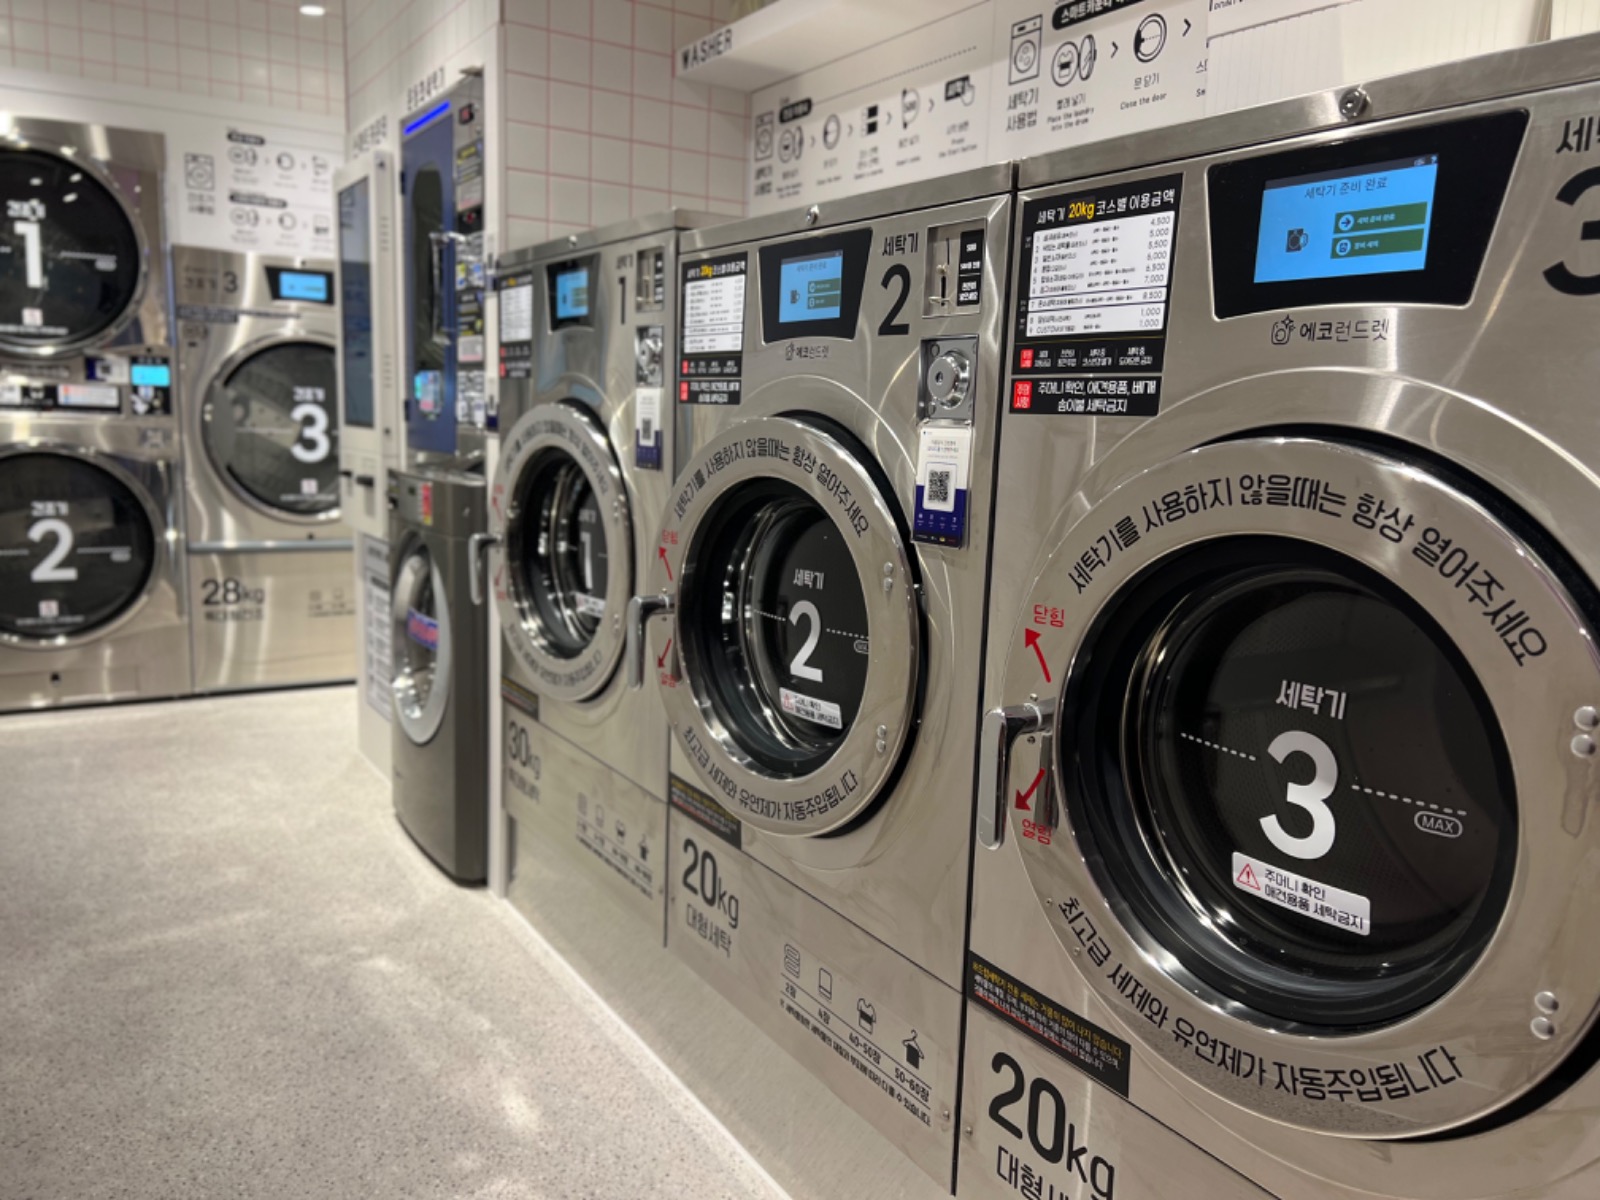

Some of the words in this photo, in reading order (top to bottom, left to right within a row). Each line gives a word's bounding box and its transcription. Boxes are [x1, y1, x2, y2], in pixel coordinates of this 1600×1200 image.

[682, 29, 732, 69] WASHER
[1151, 92, 1167, 102] door
[1037, 207, 1066, 224] 세탁기
[1068, 202, 1096, 220] 20kg
[1096, 197, 1128, 216] 코스별
[1129, 188, 1176, 210] 이용금액
[1305, 184, 1336, 199] 세탁기
[1339, 180, 1361, 196] 준비
[1365, 176, 1388, 191] 완료
[14, 220, 43, 288] 1
[882, 232, 919, 255] 세탁기
[223, 271, 238, 293] 3
[878, 264, 911, 336] 2
[1298, 320, 1389, 343] 에코런드렛
[1038, 382, 1064, 395] 주머니
[1086, 398, 1128, 413] 세탁금지
[290, 402, 330, 463] 3
[675, 469, 706, 522] 세탁기를
[705, 441, 744, 478] 사용하지
[746, 437, 790, 461] 않을때는
[792, 446, 816, 474] 항상
[816, 462, 869, 538] 열어주세요
[27, 518, 78, 582] 2
[793, 569, 824, 590] 세탁기
[1068, 515, 1142, 595] 세탁기를
[1142, 476, 1233, 533] 사용하지
[1239, 473, 1347, 519] 않을때는
[1352, 492, 1416, 544] 항상
[1411, 527, 1548, 668] 열어주세요
[1033, 604, 1065, 628] 닫힘
[789, 600, 823, 682] 2
[1275, 679, 1347, 720] 세탁기
[739, 788, 781, 820] 유연제가
[783, 768, 859, 821] 자동주입됩니다
[1259, 730, 1339, 860] 3
[1022, 819, 1053, 846] 열림
[1421, 815, 1455, 835] MAX
[683, 838, 738, 929] 20kg
[1264, 868, 1299, 893] 주머니
[1301, 882, 1326, 901] 확인
[1264, 883, 1310, 913] 애견용품
[1312, 902, 1363, 931] 세탁금지
[1058, 896, 1112, 967] 최고급
[1106, 963, 1169, 1029] 세제와
[1171, 1017, 1268, 1086] 유연제가
[1272, 1045, 1463, 1103] 자동주입됩니다
[988, 1052, 1115, 1200] 20kg
